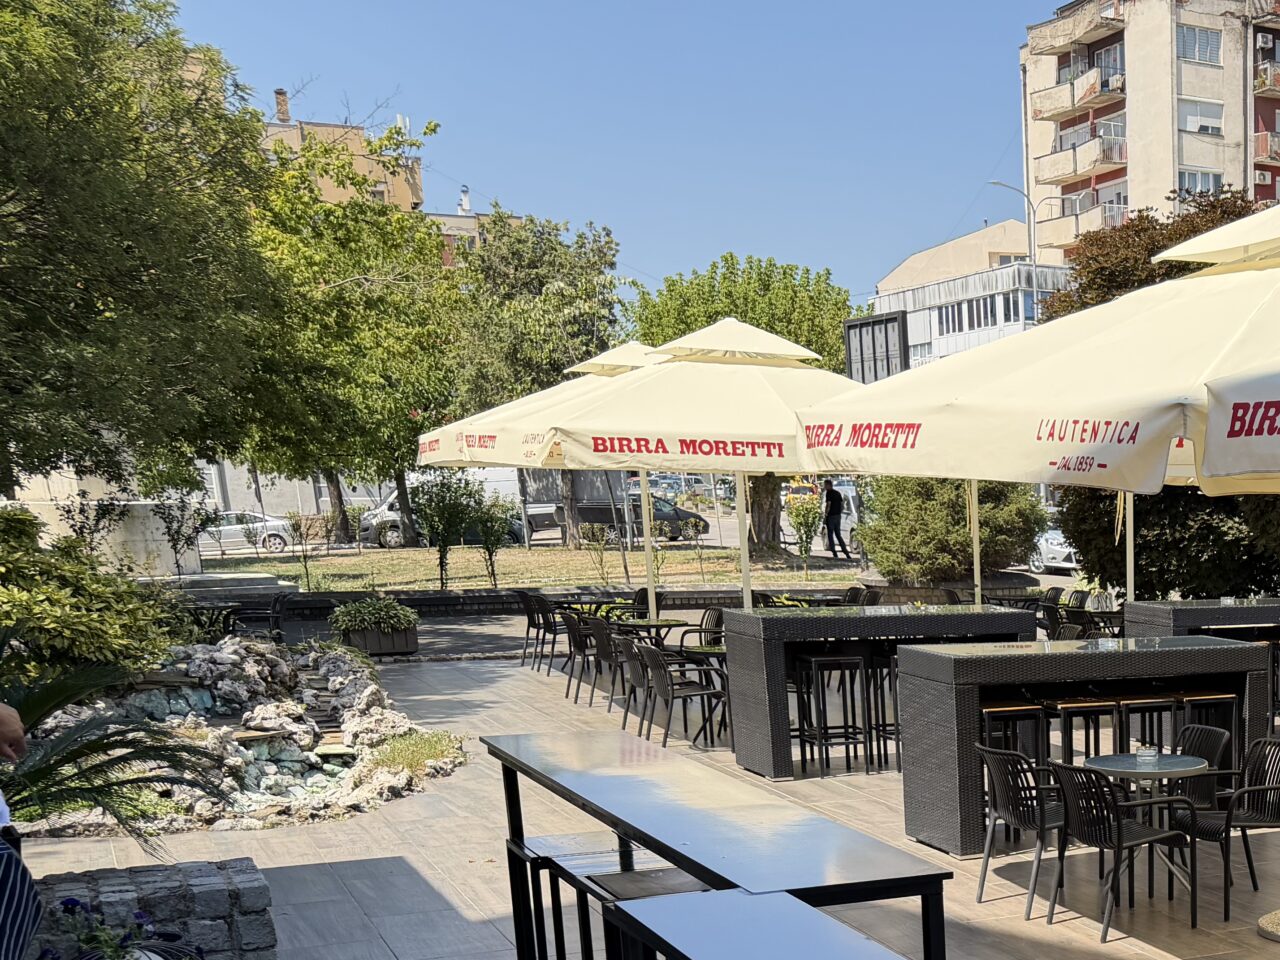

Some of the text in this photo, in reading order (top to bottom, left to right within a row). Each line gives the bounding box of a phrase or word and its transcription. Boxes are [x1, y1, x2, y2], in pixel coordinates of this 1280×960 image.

[804, 422, 922, 450] BIRRA MORETTI
[1036, 418, 1140, 445] L'AUTENTICA
[591, 436, 785, 458] BIRRA MORETTI
[1057, 455, 1095, 472] DAL 1859
